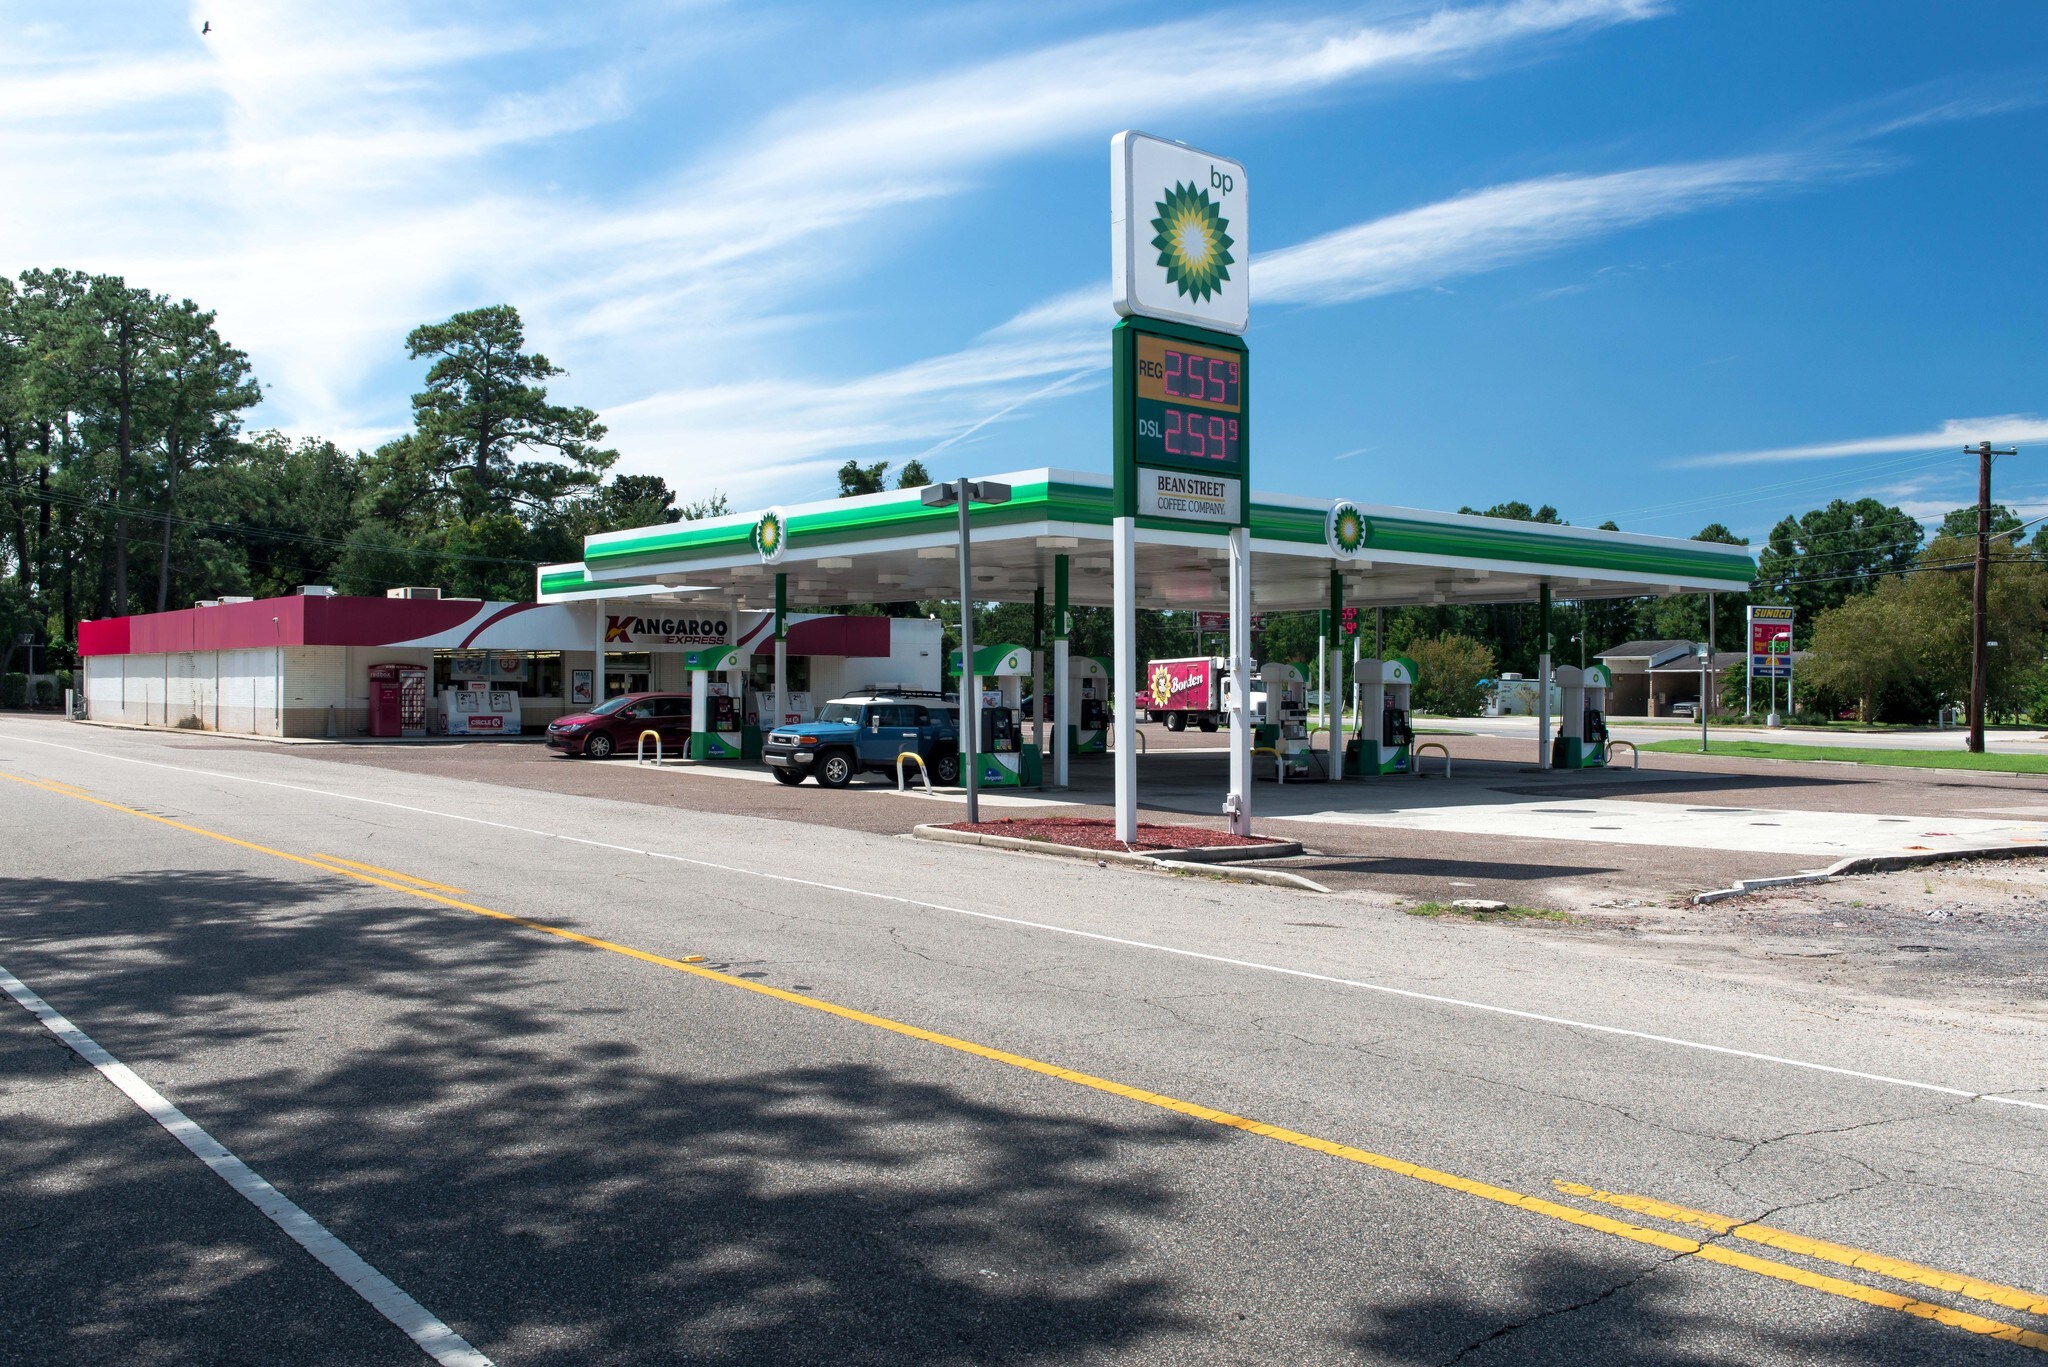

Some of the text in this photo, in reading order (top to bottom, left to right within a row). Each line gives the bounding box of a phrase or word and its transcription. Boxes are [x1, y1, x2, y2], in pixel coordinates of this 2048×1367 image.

[1211, 165, 1233, 196] bp
[1139, 360, 1163, 379] REG
[1139, 419, 1162, 438] DSL
[1157, 476, 1226, 498] BEAN STREET
[1157, 497, 1187, 512] COFFEE
[1754, 608, 1792, 619] SUNOCO
[605, 615, 728, 644] KANGAROO
[666, 635, 725, 645] EXPRESS
[1170, 672, 1204, 694] Borden
